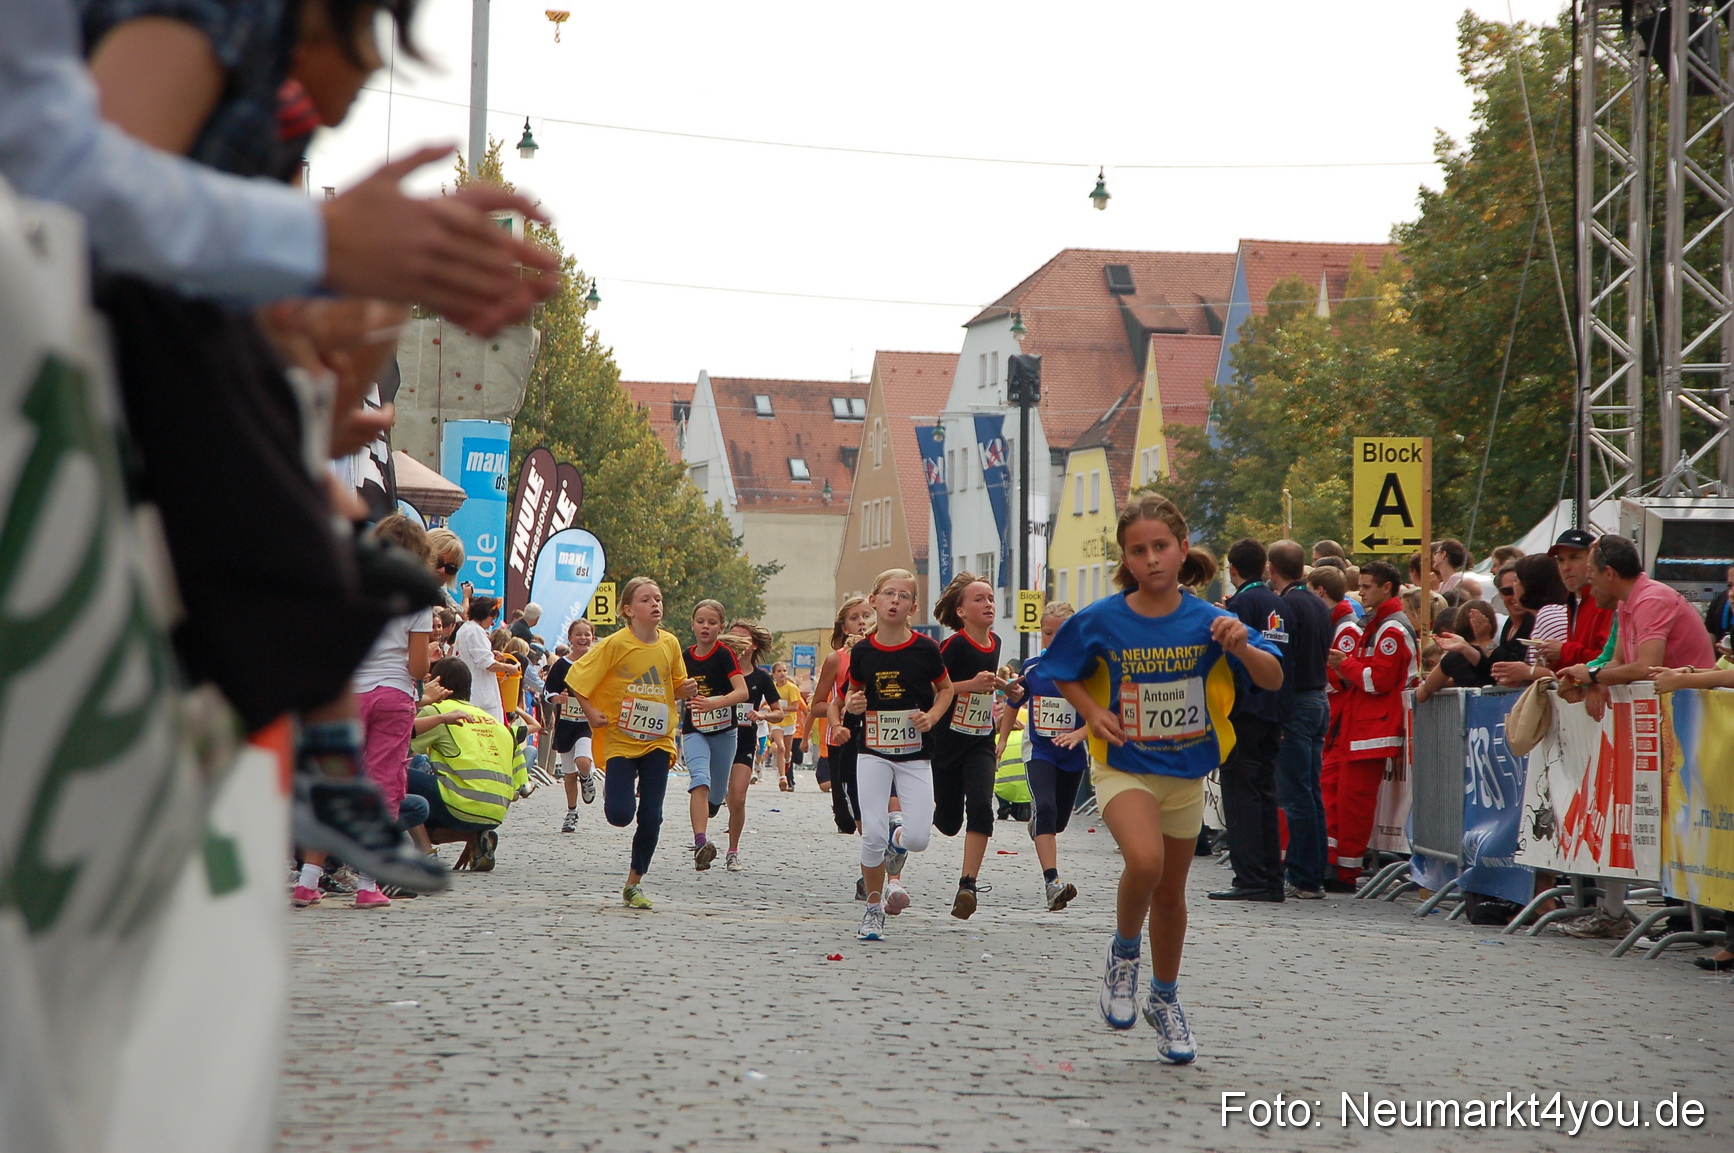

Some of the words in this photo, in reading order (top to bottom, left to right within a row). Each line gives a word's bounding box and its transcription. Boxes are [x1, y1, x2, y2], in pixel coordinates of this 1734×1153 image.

[1363, 443, 1422, 462] Block
[466, 451, 506, 474] maxi
[1370, 473, 1414, 527] A
[509, 465, 544, 574] THULE
[548, 488, 577, 537] LE
[524, 490, 552, 590] PROFESSIONAL
[466, 533, 498, 595] l.de
[558, 551, 587, 567] maxi
[576, 566, 589, 577] dsl
[1020, 591, 1042, 600] Block
[595, 596, 609, 615] B
[1024, 603, 1037, 622] B
[1121, 658, 1196, 674] STADTLAUF
[627, 683, 666, 696] adidas
[1144, 688, 1185, 703] Antonia
[634, 702, 649, 712] Nina
[970, 696, 980, 705] Ida
[1041, 700, 1060, 709] Selina
[568, 706, 584, 715] 729
[703, 708, 729, 721] 7132
[737, 712, 749, 721] 85
[1042, 712, 1072, 724] 7145
[1146, 706, 1199, 729] 7022
[632, 715, 664, 731] 7195
[880, 714, 901, 725] Fanny
[881, 727, 917, 741] 7218
